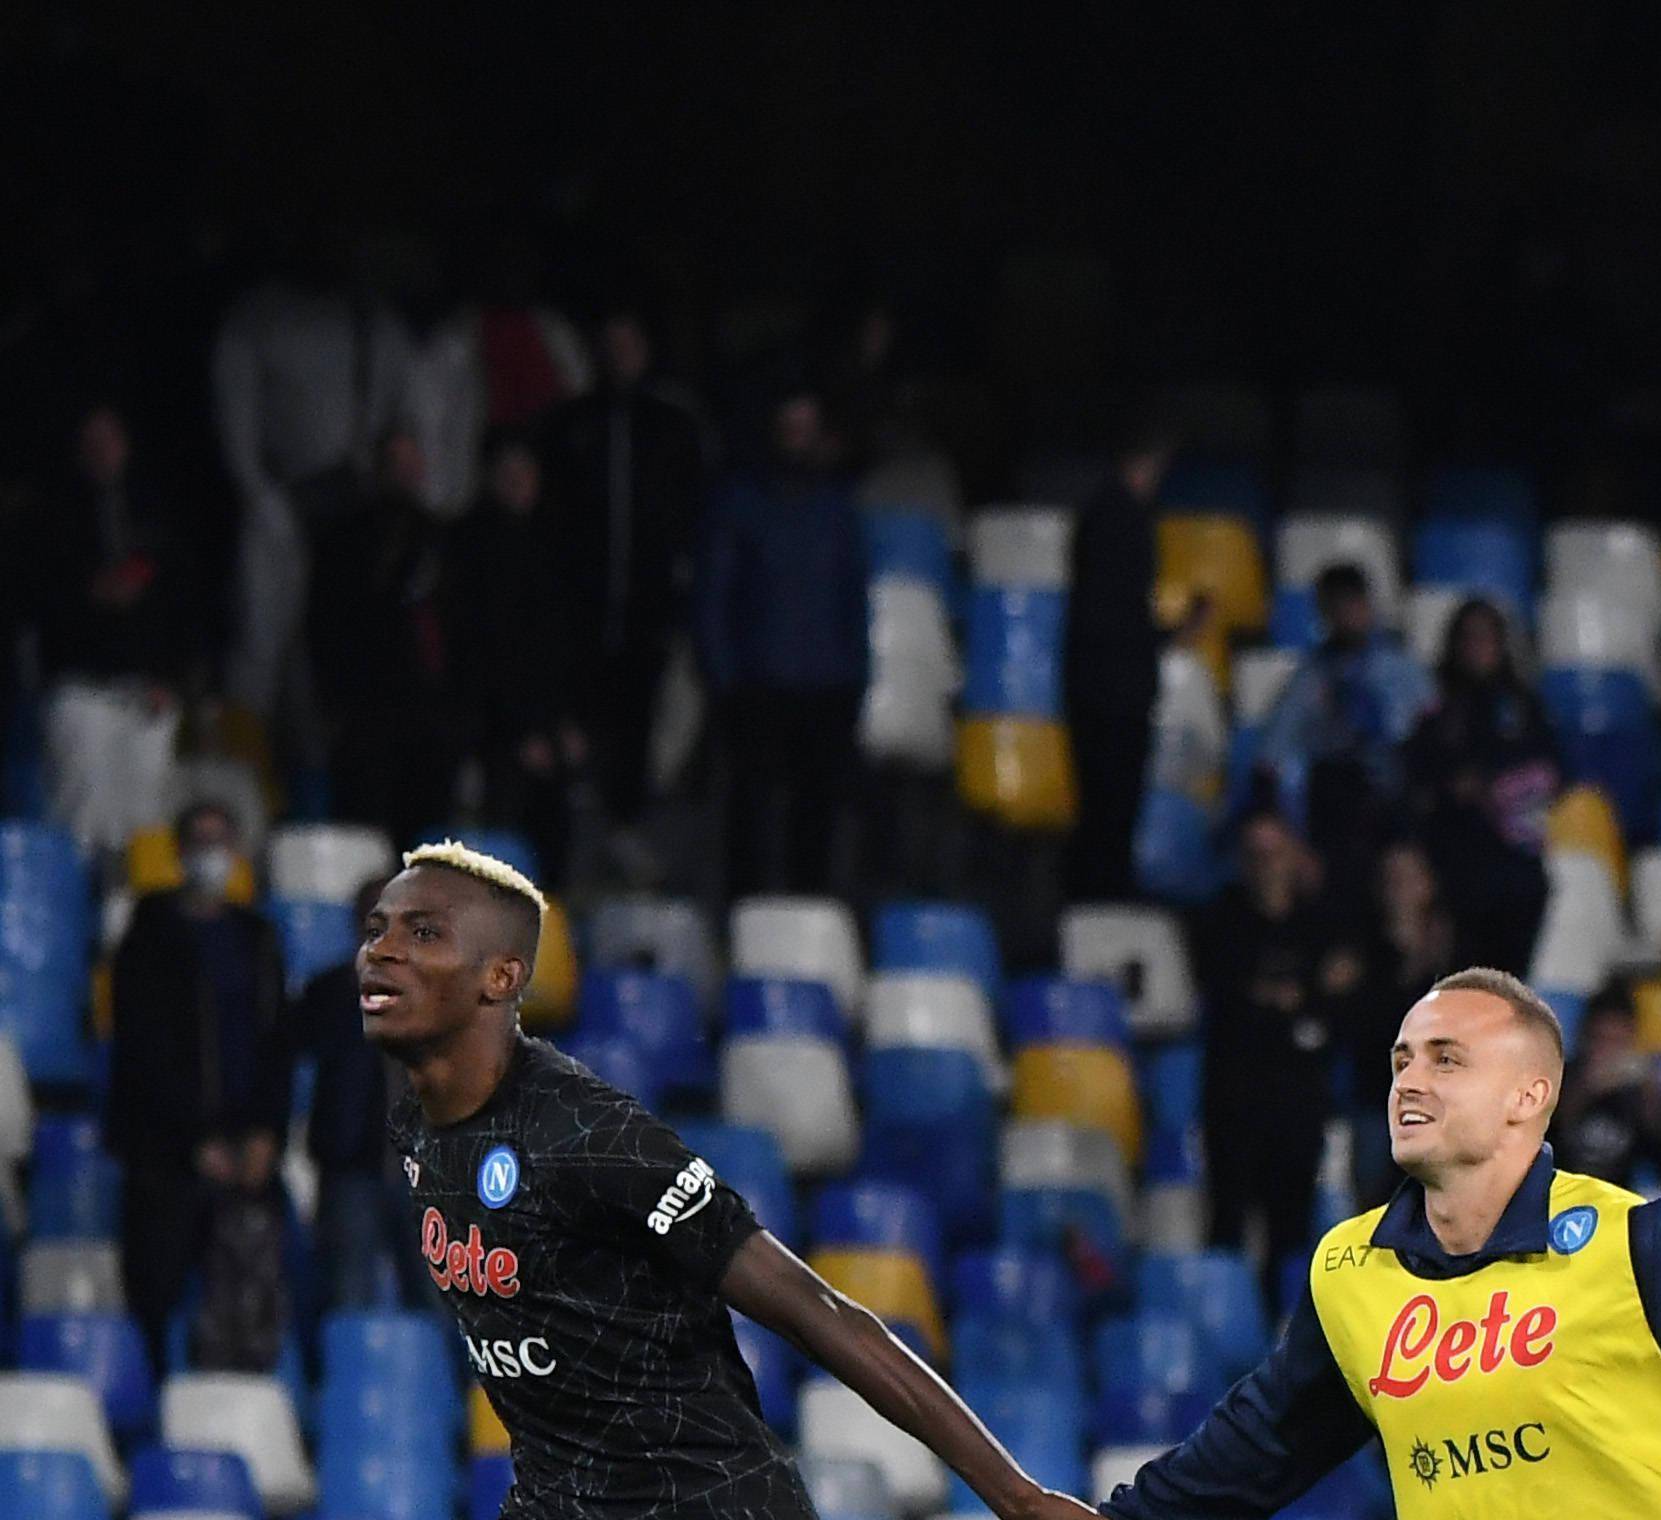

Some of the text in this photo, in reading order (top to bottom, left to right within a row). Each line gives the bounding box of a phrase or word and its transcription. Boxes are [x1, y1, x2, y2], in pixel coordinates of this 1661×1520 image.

[487, 1162, 510, 1191] N
[1562, 1217, 1588, 1242] N
[422, 1206, 520, 1298] Lete
[1324, 1245, 1372, 1272] EA7
[466, 1335, 556, 1377] MSC
[1368, 1291, 1558, 1400] Lete
[1442, 1422, 1550, 1479] MSC
